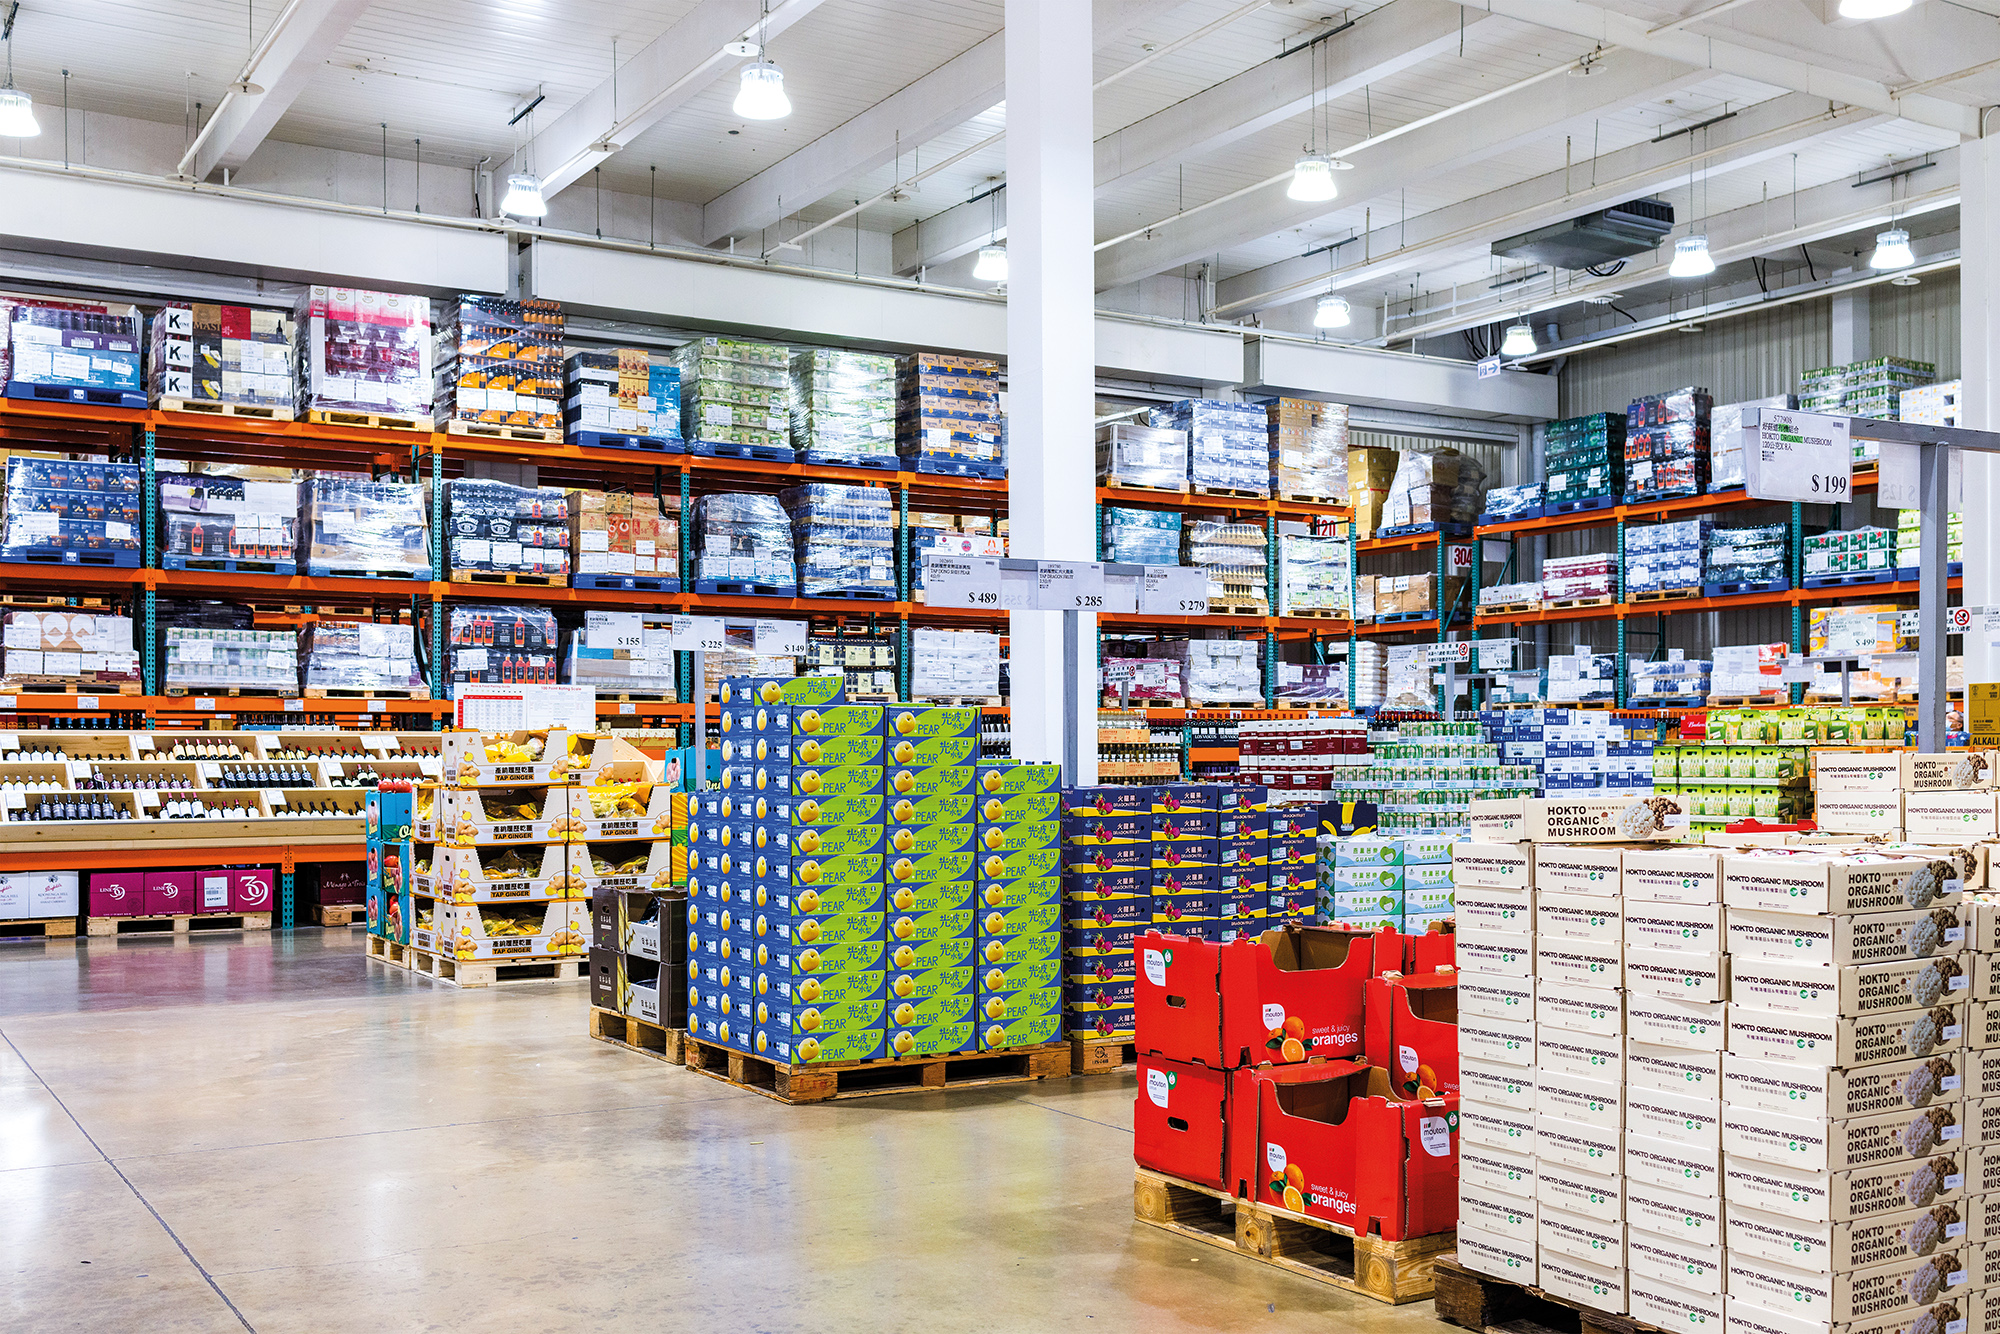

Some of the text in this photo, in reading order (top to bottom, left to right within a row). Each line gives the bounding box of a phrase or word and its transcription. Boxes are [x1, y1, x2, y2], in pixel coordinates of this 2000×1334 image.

[1812, 474, 1846, 494] $ 199
[1454, 548, 1472, 566] 304
[969, 592, 997, 603] $ 489
[1076, 596, 1102, 606] $ 285
[1180, 600, 1204, 610] $ 279
[618, 637, 640, 645] $ 155
[701, 640, 722, 648] $ 225
[1862, 638, 1875, 646] 499
[784, 644, 790, 652] $
[783, 692, 806, 704] PEAR
[823, 722, 846, 733] PEAR
[917, 753, 938, 764] PEAR
[1005, 781, 1026, 792] PEAR
[1914, 779, 1952, 788] MUSHROOM
[1548, 806, 1587, 815] HOKTO
[1548, 816, 1599, 825] ORGANIC
[1548, 827, 1616, 836] MUSHROOM
[917, 840, 938, 851] PEAR
[822, 871, 845, 882] PEAR
[1648, 870, 1675, 878] ORGANIC
[1677, 871, 1714, 880] MUSHROOM
[1848, 873, 1880, 884] HOKTO
[1727, 875, 1824, 887] HOKTO ORGANIC MUSHROOM
[111, 884, 125, 900] 39
[163, 882, 178, 898] 39
[239, 876, 269, 905] 39
[1848, 884, 1891, 896] ORGANIC
[1847, 896, 1903, 909] MUSHROOM
[1146, 959, 1163, 968] mouton
[1859, 973, 1889, 985] HOKTO
[1858, 984, 1900, 998] ORGANIC
[1857, 995, 1912, 1010] MUSHROOM
[917, 1012, 938, 1023] PEAR
[1265, 1009, 1283, 1020] mouton
[1312, 1026, 1330, 1034] sweet
[1337, 1024, 1350, 1034] juicy
[1005, 1034, 1026, 1044] PEAR
[1312, 1032, 1358, 1047] oranges
[821, 1048, 845, 1059] PEAR
[1401, 1053, 1417, 1063] mouton
[1149, 1080, 1167, 1090] mouton
[1423, 1127, 1446, 1137] mouton
[1269, 1151, 1285, 1161] mouton
[1850, 1176, 1882, 1190] HOKTO
[1311, 1183, 1348, 1199] sweet & juicy
[1850, 1186, 1892, 1202] ORGANIC
[1311, 1193, 1356, 1214] oranges
[1850, 1196, 1906, 1215] MUSHROOM
[1632, 1290, 1719, 1319] HOKTO ORGANIC MUSHROOM
